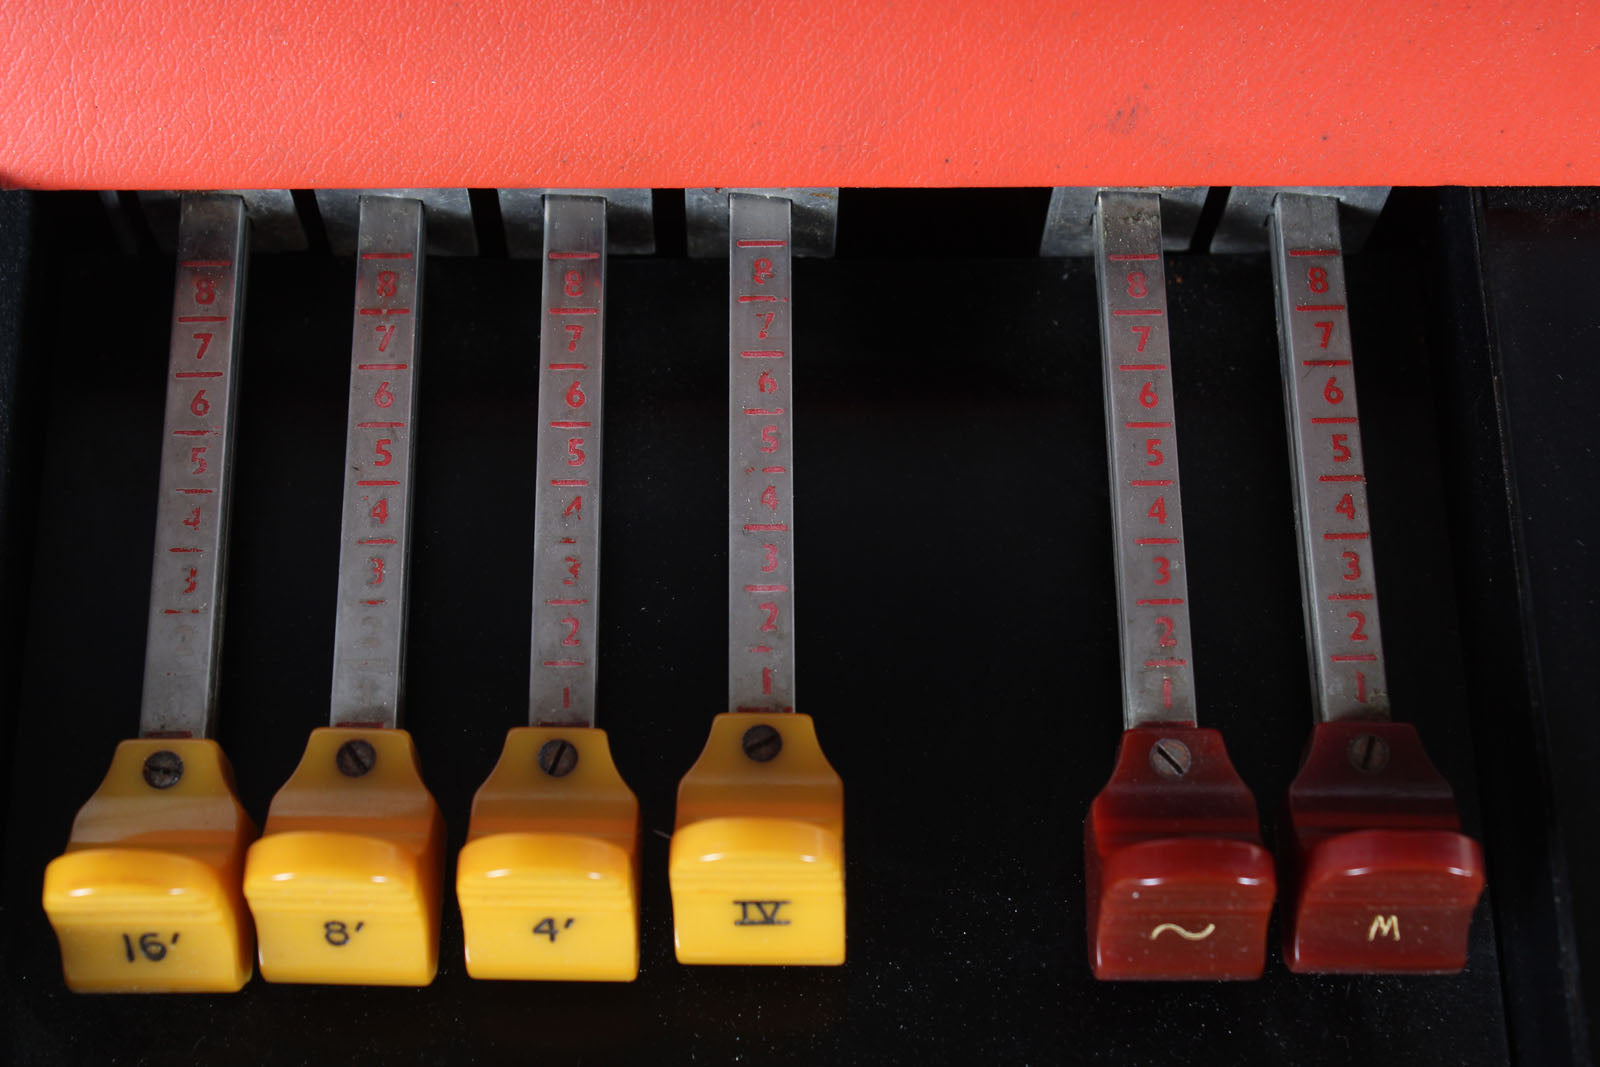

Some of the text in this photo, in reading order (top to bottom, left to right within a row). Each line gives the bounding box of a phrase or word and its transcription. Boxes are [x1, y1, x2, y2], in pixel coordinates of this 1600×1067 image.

[194, 277, 215, 304] 8
[376, 271, 397, 298] 8
[564, 270, 585, 297] 8
[1127, 271, 1149, 299] 8
[1308, 267, 1329, 294] 8
[376, 325, 395, 352] 7
[564, 325, 584, 352] 7
[755, 312, 775, 339] 7
[1131, 326, 1152, 353] 7
[1313, 322, 1335, 349] 7
[193, 333, 213, 360] 7
[374, 382, 395, 409] 6
[565, 381, 586, 408] 6
[757, 369, 779, 394] 6
[1138, 382, 1160, 409] 6
[1323, 377, 1345, 405] 6
[190, 389, 211, 417] 6
[374, 438, 393, 467] 5
[567, 438, 587, 467] 5
[760, 425, 781, 454] 5
[1146, 438, 1165, 467] 5
[1331, 434, 1351, 462] 5
[191, 447, 208, 475] 5
[370, 498, 389, 525] 4
[760, 485, 779, 511] 4
[1147, 496, 1169, 525] 4
[1335, 493, 1357, 520] 4
[369, 557, 385, 585] 3
[761, 543, 779, 573] 3
[1152, 556, 1172, 586] 3
[1341, 551, 1362, 581] 3
[759, 602, 780, 633] 2
[1346, 611, 1369, 641] 2
[561, 617, 581, 647] 2
[1154, 616, 1178, 648] 2
[762, 667, 773, 695] 1
[1162, 677, 1173, 710] 1
[1356, 671, 1367, 704] 1
[563, 687, 571, 709] 1
[733, 900, 793, 926] IV
[1367, 914, 1401, 942] M
